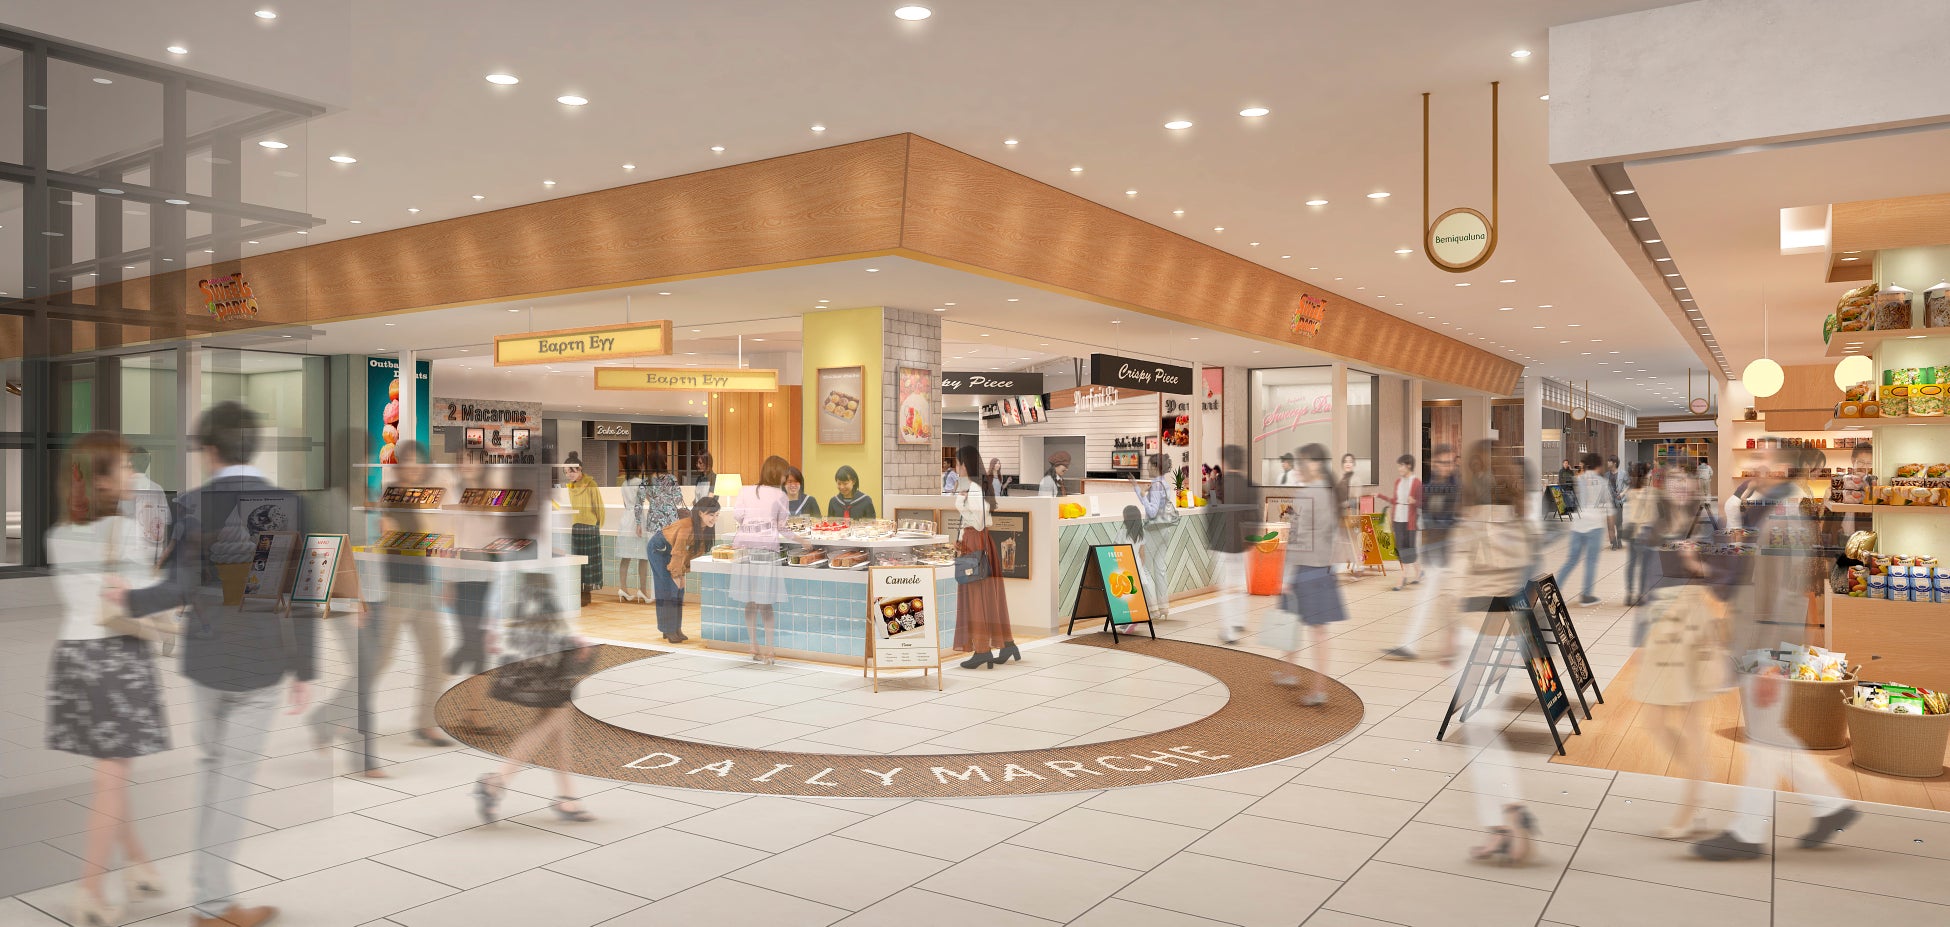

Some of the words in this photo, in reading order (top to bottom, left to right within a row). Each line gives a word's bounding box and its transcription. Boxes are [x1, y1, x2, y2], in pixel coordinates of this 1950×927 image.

[1435, 233, 1485, 244] Bemiqualuna
[369, 360, 399, 368] Outba
[1118, 363, 1152, 384] Crispy
[1154, 368, 1179, 384] Piece
[969, 376, 1013, 388] Piece
[448, 404, 457, 421] 2
[461, 405, 527, 423] Macarons
[479, 449, 535, 464] Cupcake
[885, 575, 921, 585] Cannele
[622, 752, 903, 787] DAILY
[930, 745, 1230, 784] MARCHE
